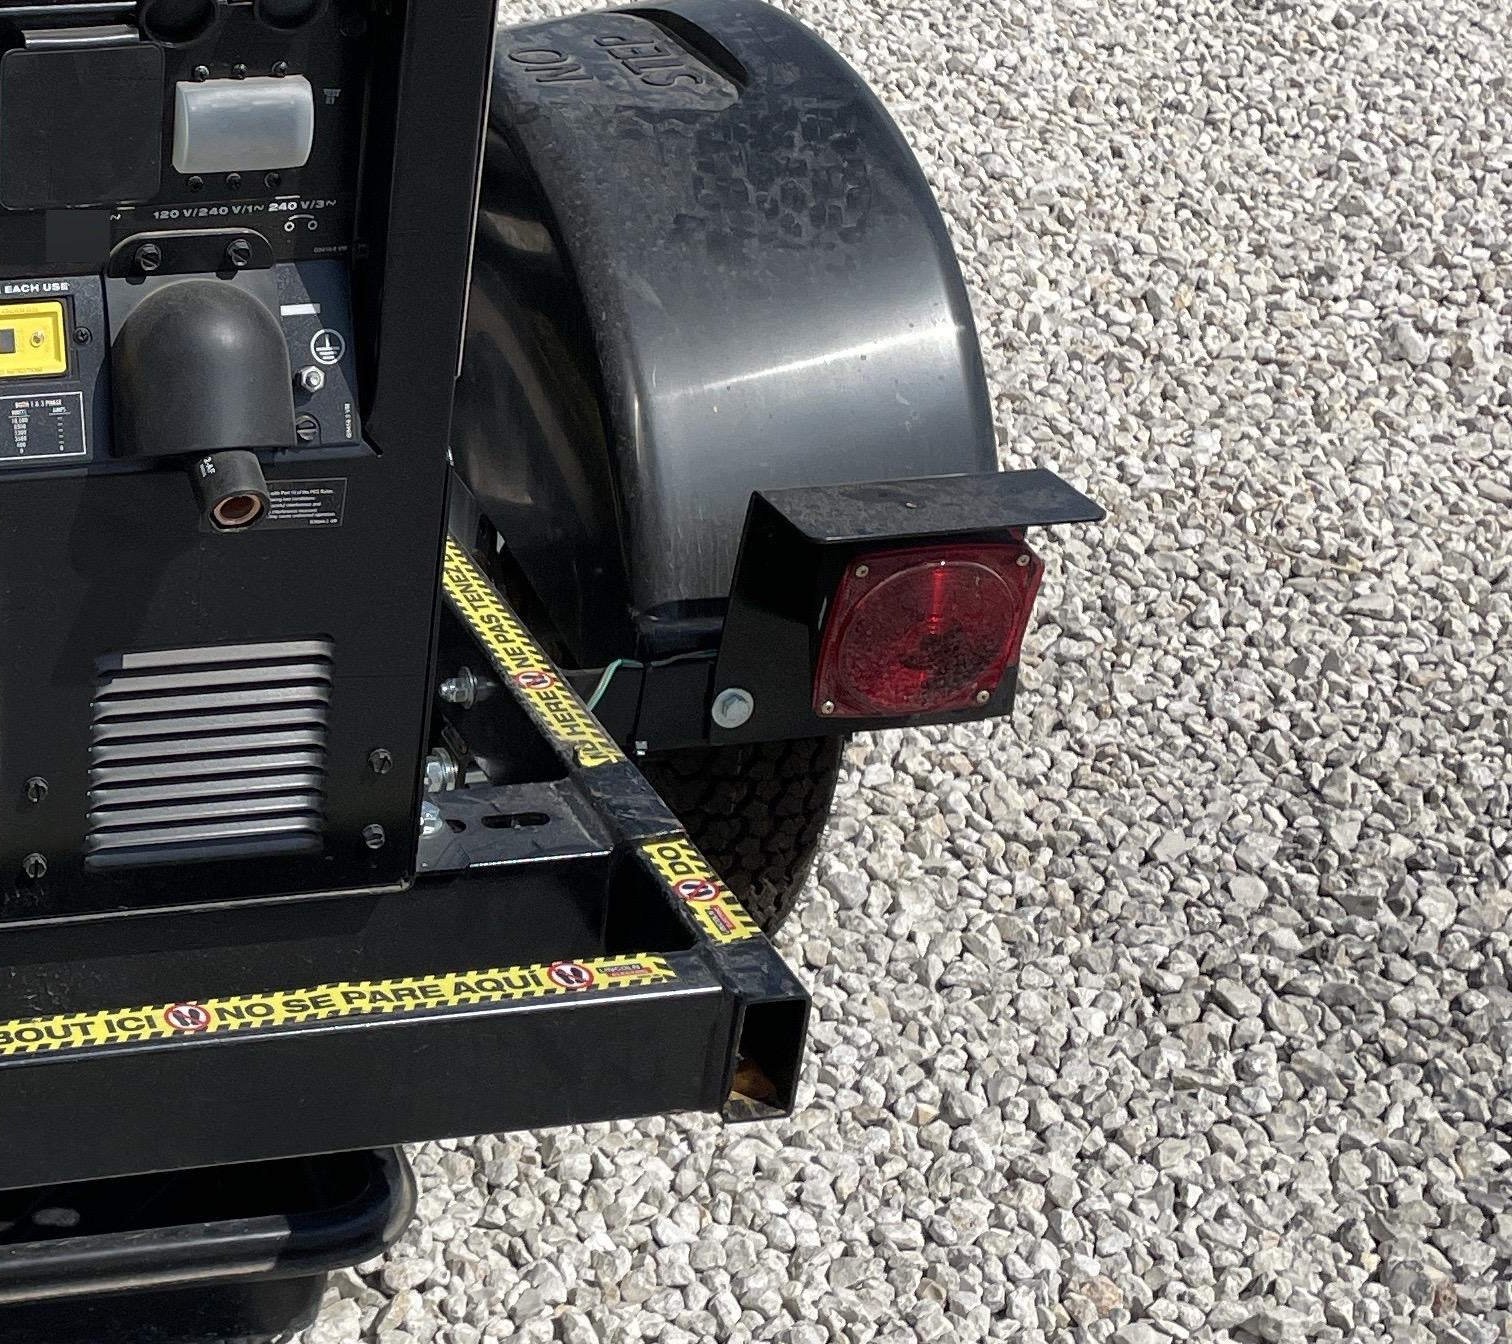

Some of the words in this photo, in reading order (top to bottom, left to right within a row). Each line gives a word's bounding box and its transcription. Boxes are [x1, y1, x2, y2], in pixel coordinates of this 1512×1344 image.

[153, 209, 180, 219] 120
[182, 206, 228, 217] V/240
[268, 201, 297, 212] 240
[5, 283, 39, 294] EACH
[42, 282, 69, 292] USE
[445, 564, 490, 612] TENEZ
[479, 613, 516, 644] PAS
[502, 646, 535, 669] NE
[535, 689, 587, 736] HERE
[657, 846, 695, 876] DO
[217, 1001, 275, 1022] NO
[282, 994, 334, 1014] SE
[341, 982, 442, 1006] PARE
[452, 969, 544, 993] AQUÍ
[105, 1014, 156, 1033] ICI
